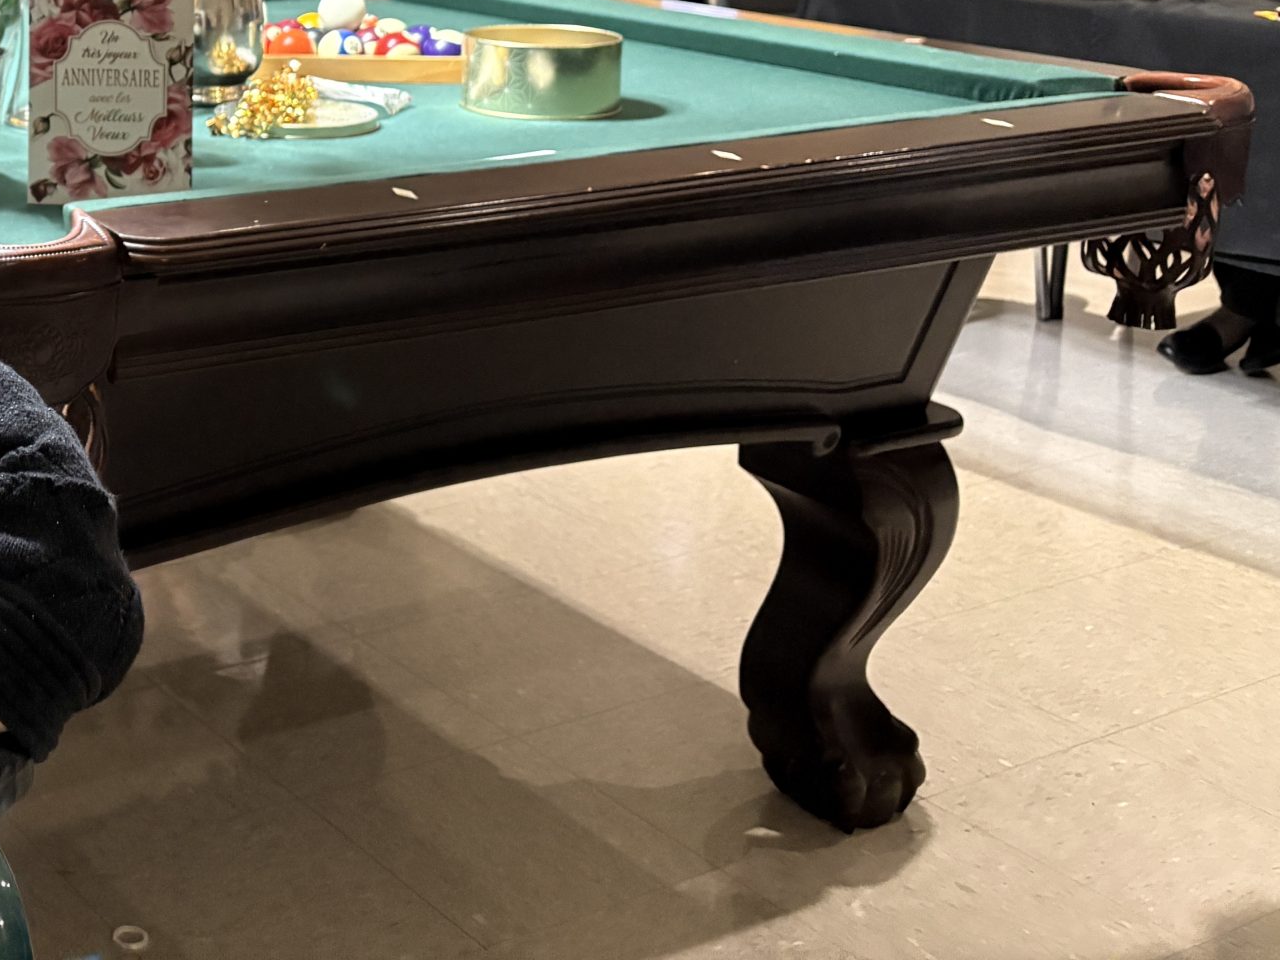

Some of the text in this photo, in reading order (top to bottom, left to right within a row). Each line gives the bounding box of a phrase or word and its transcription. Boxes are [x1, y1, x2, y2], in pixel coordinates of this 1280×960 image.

[99, 29, 120, 44] Un
[81, 47, 138, 65] très joyeux
[62, 68, 160, 88] ANNIVERSAIRE
[88, 91, 132, 104] avec les
[74, 106, 144, 124] Meilleurs
